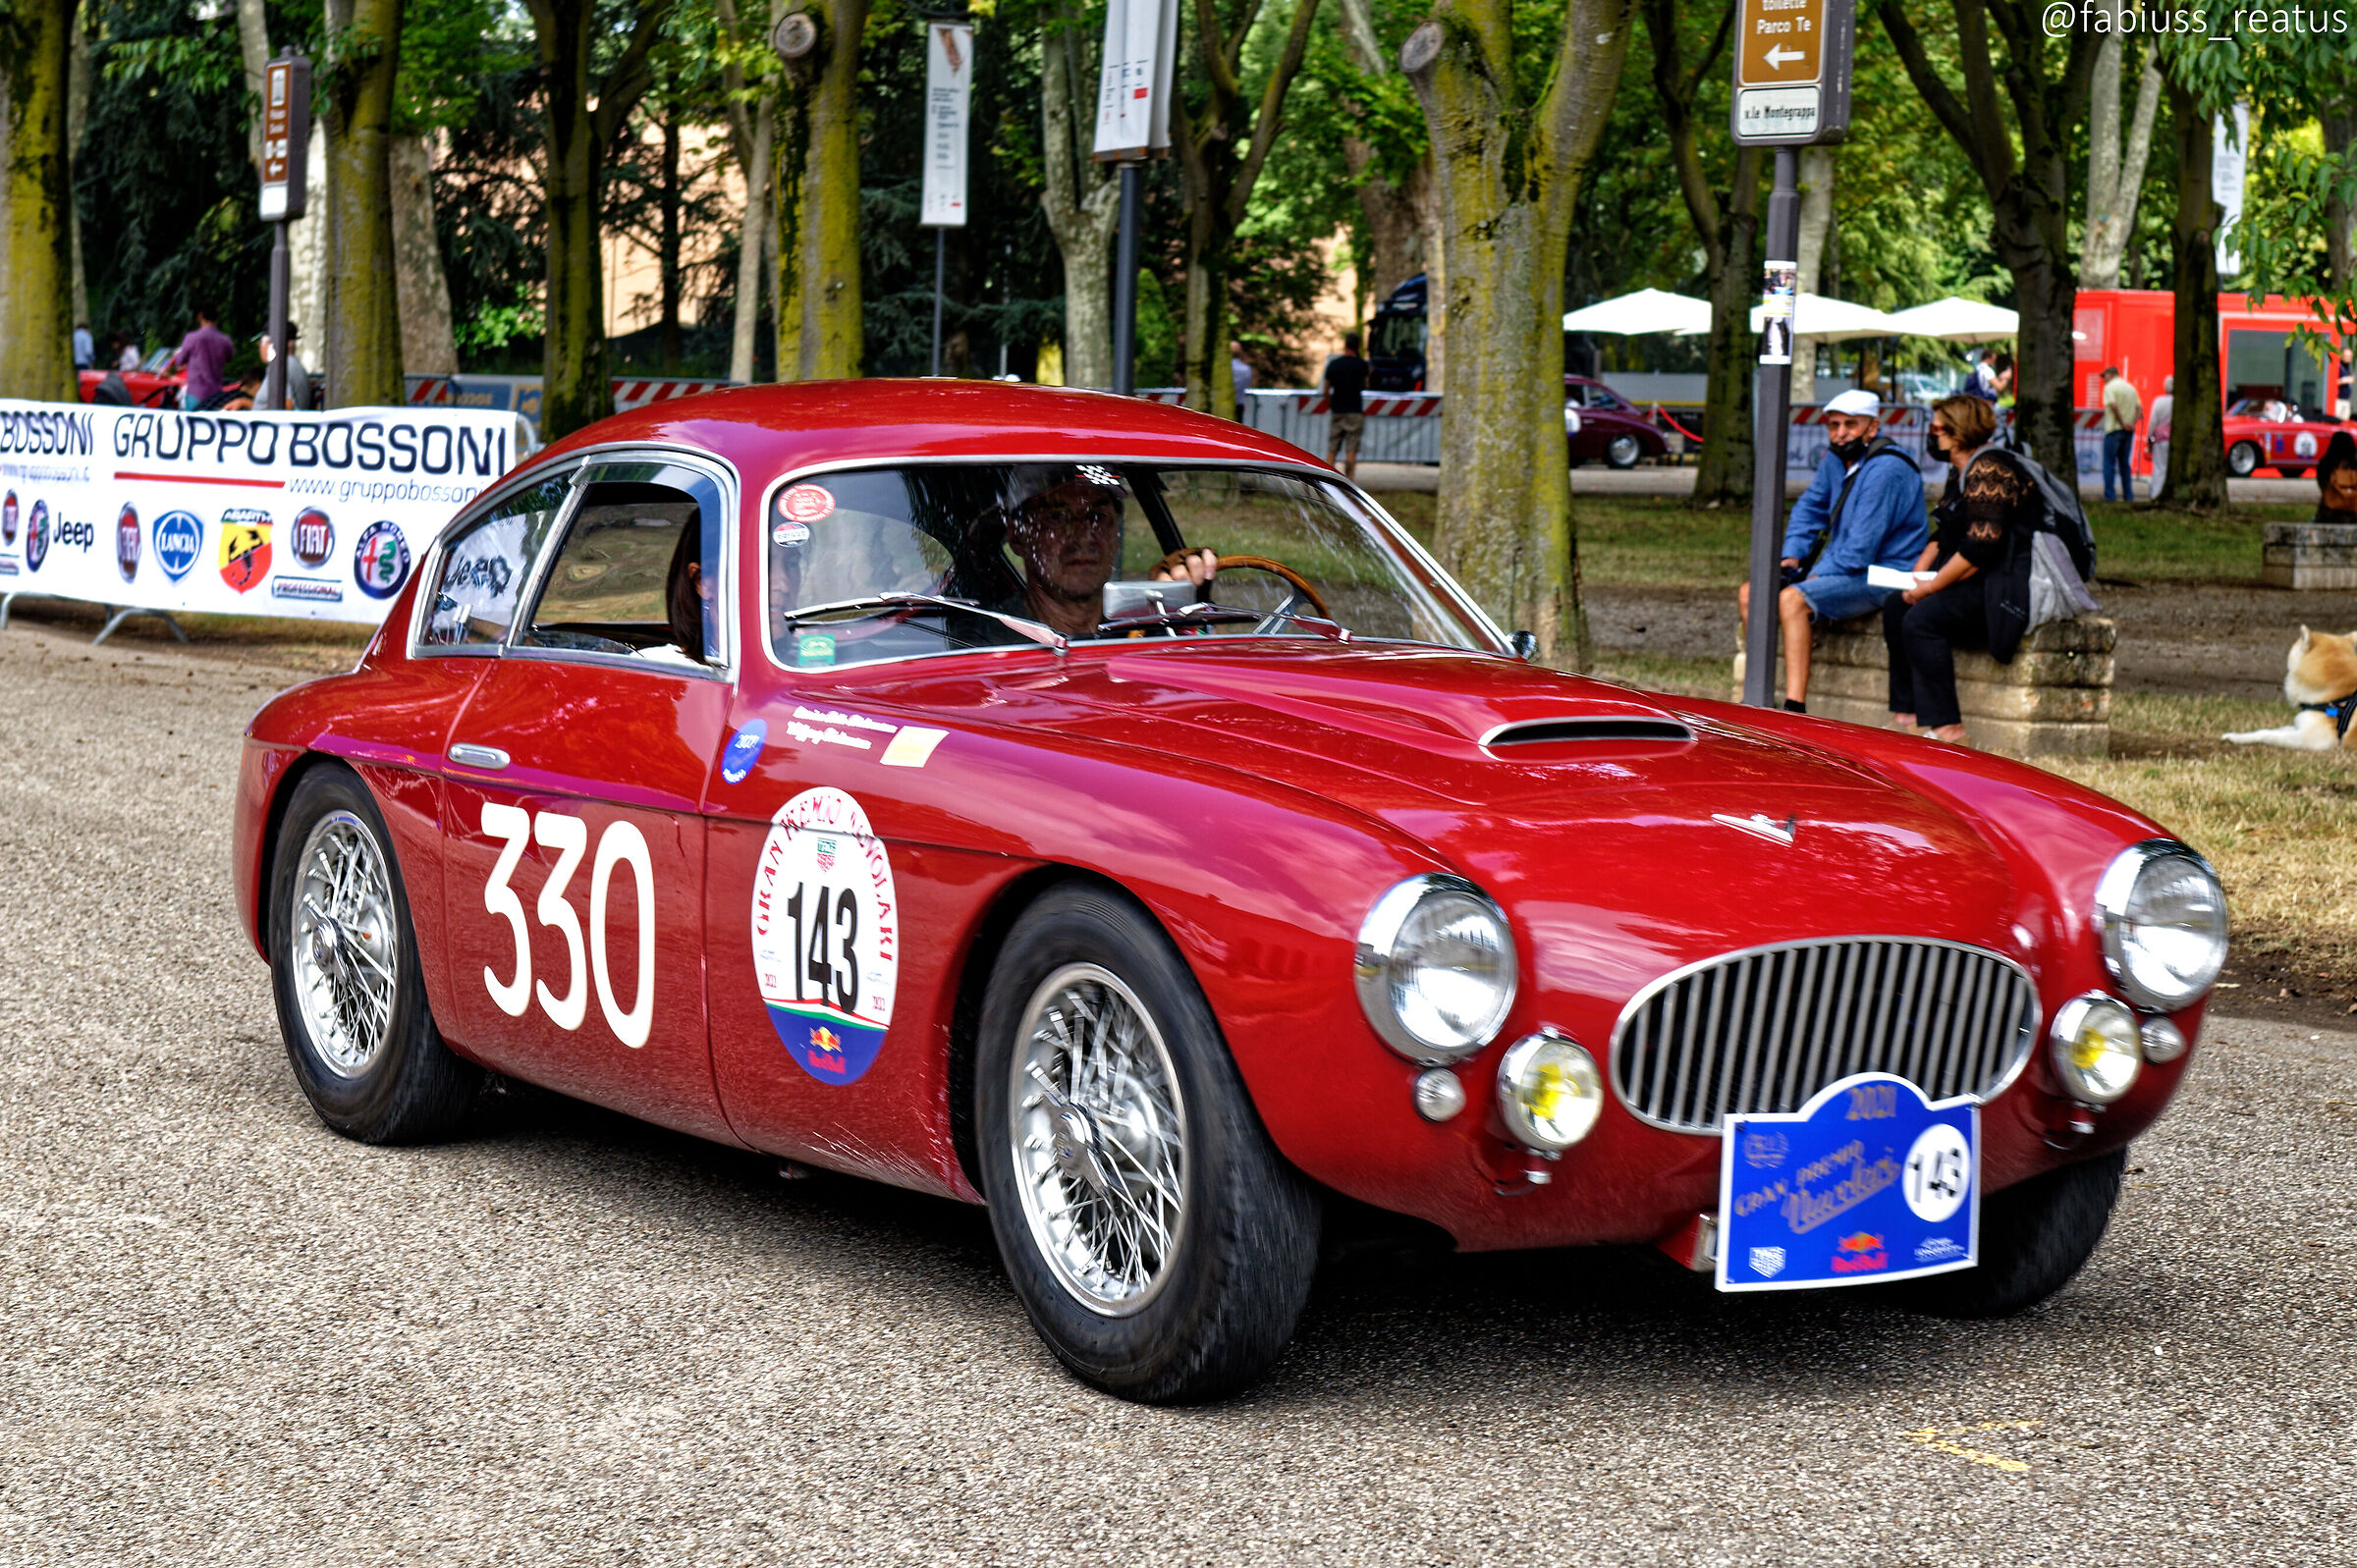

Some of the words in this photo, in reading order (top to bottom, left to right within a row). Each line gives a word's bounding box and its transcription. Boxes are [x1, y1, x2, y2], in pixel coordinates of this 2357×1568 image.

[1756, 19, 1791, 34] Parco
[1795, 16, 1812, 31] Te
[1764, 106, 1815, 120] Montegrappa
[0, 410, 94, 456] BOSSONI
[114, 412, 279, 465] GRUPPO
[290, 422, 506, 476] BOSSONI
[53, 512, 94, 553] Jeep
[160, 531, 195, 554] LANCIA
[300, 523, 328, 555] FIAT
[480, 801, 656, 1050] 330
[787, 881, 858, 1015] 143
[1907, 1147, 1963, 1205] 143
